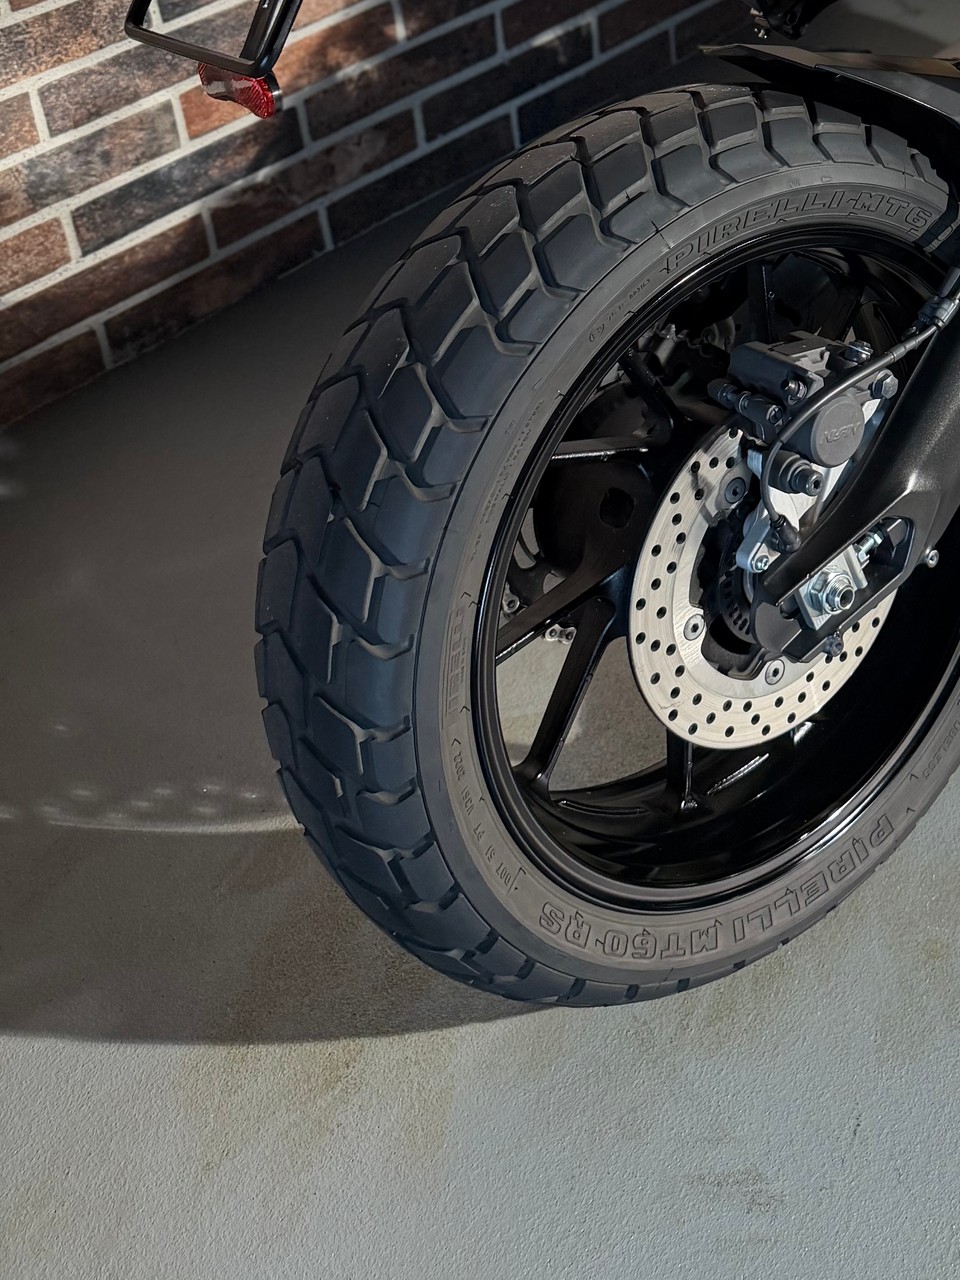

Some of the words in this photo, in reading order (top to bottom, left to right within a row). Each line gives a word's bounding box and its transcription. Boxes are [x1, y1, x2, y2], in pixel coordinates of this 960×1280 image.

[667, 190, 847, 271] PIRELLI
[733, 813, 895, 945] PIRELLI
[538, 900, 593, 950] RS
[602, 926, 719, 960] MT60
